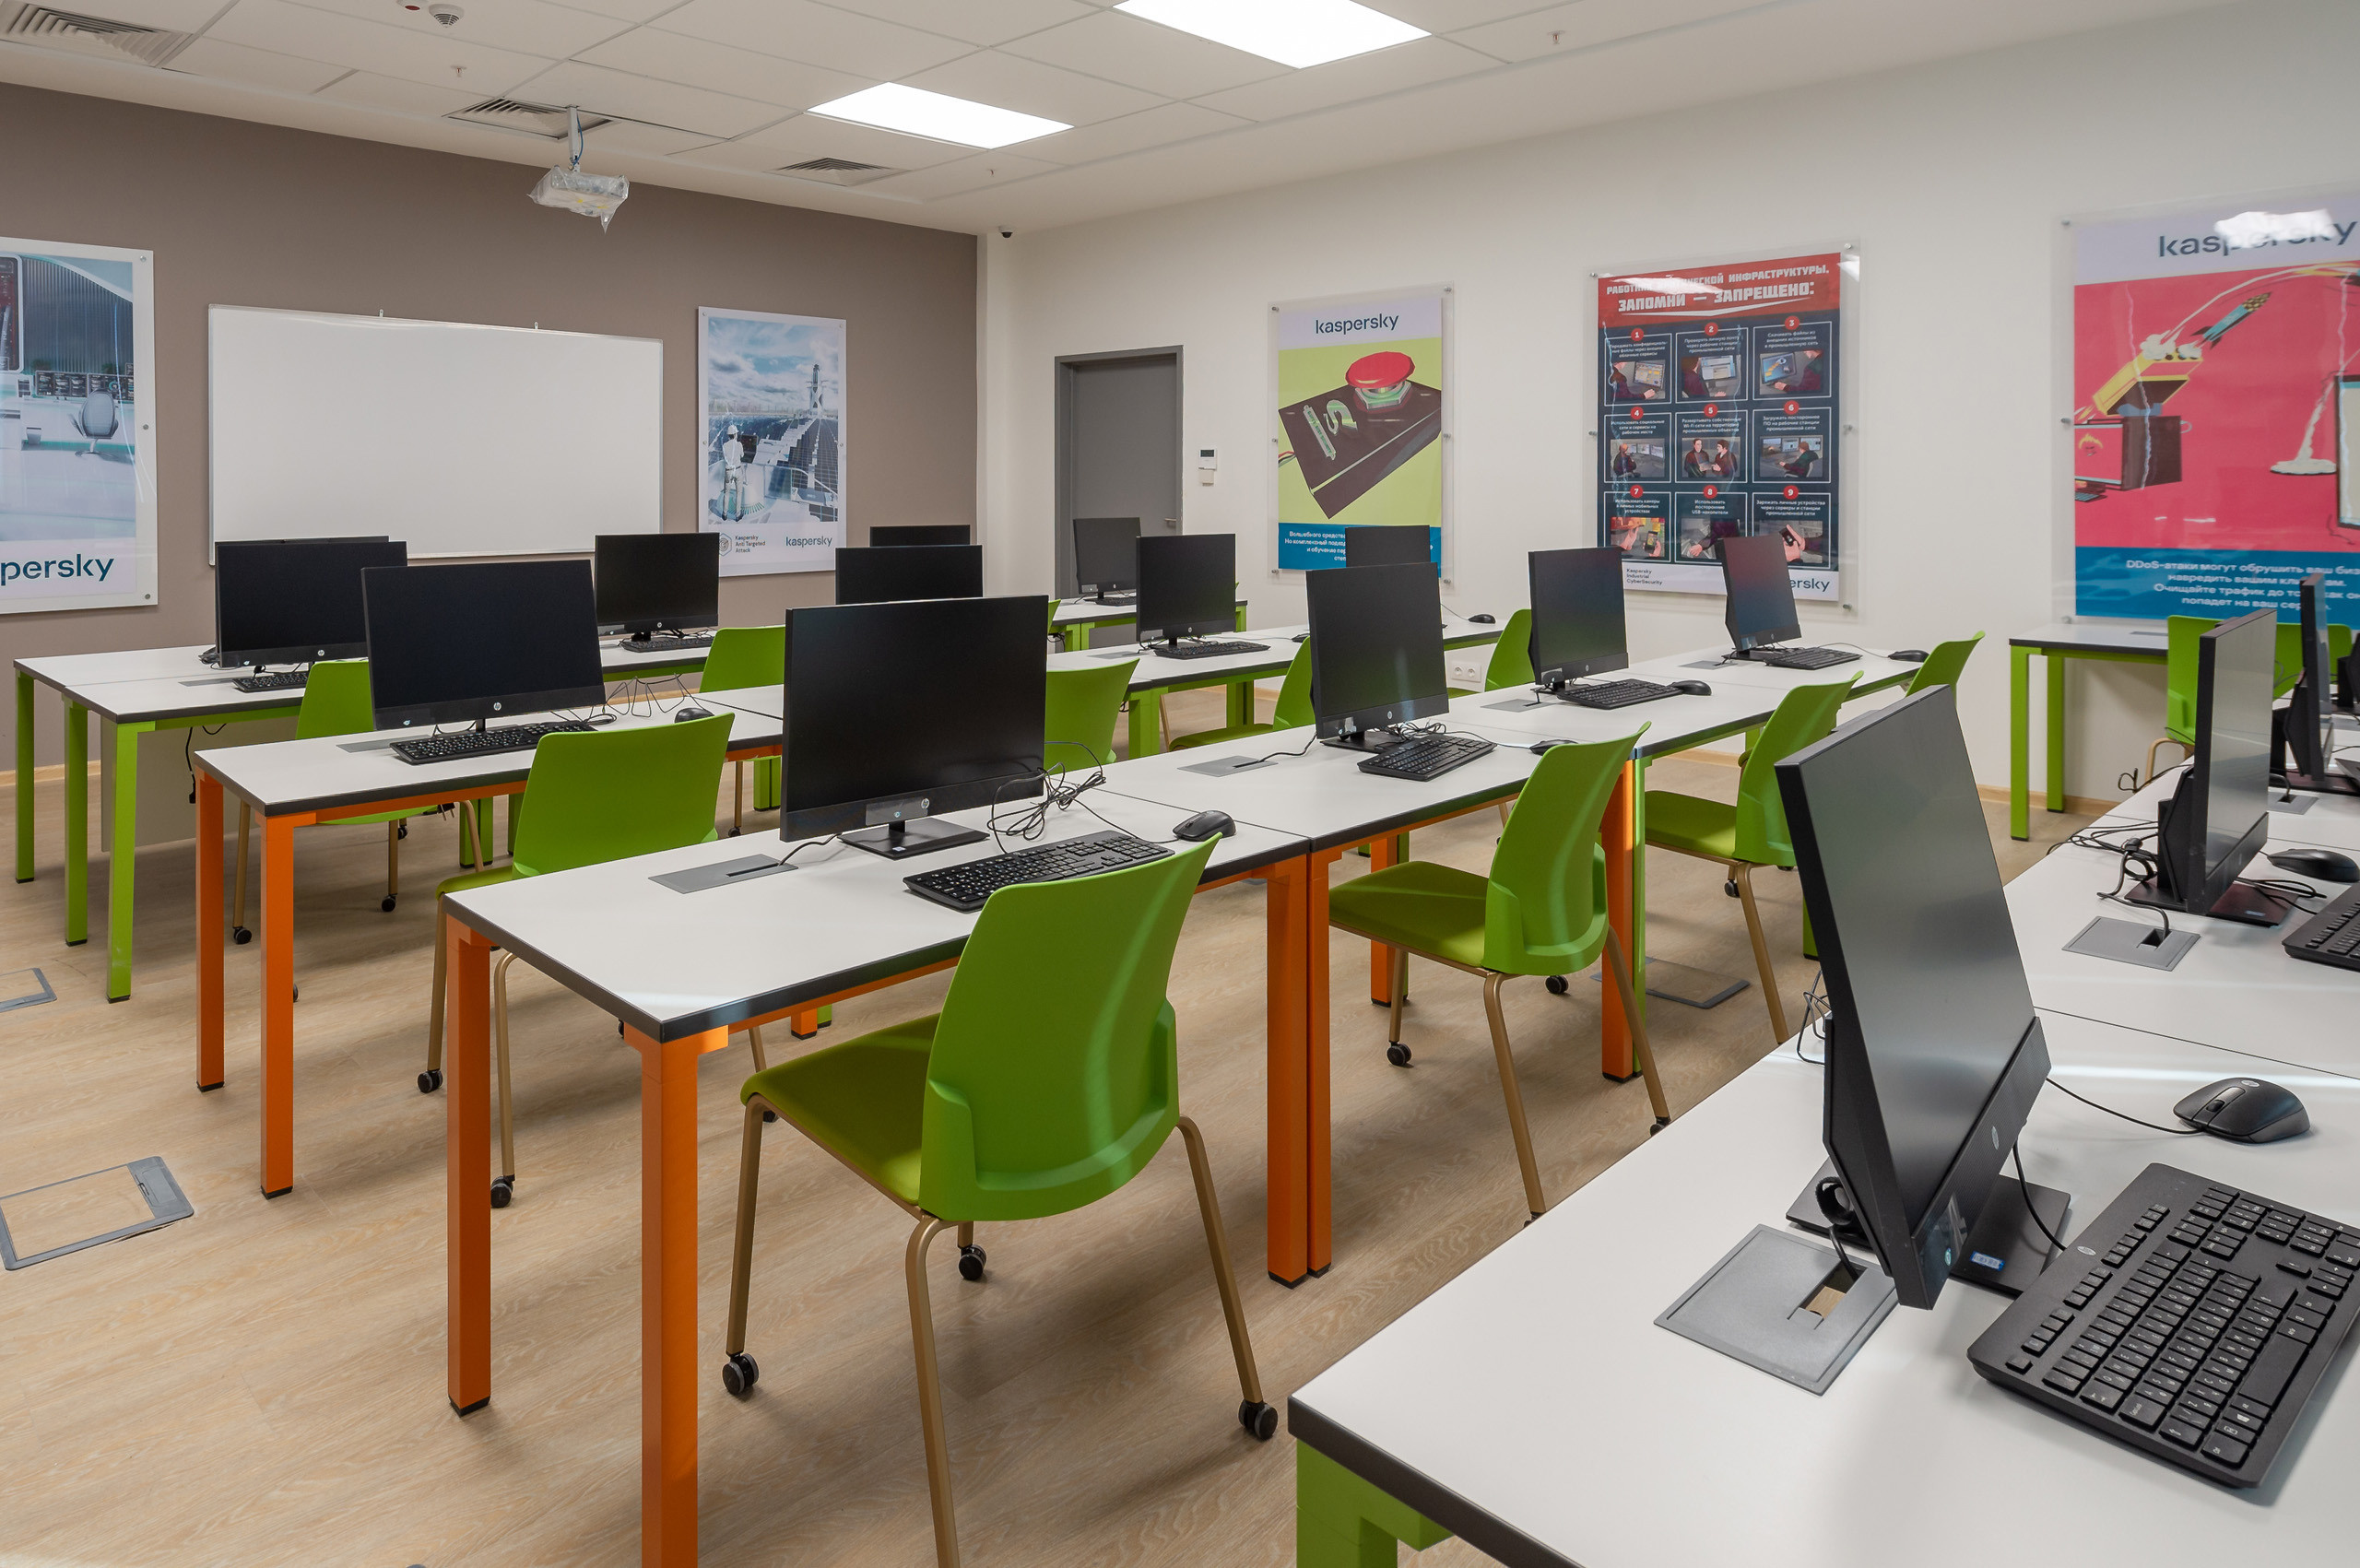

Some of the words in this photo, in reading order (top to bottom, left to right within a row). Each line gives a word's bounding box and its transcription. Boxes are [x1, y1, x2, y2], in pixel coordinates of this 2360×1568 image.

[1729, 265, 1829, 283] ИНФРАСТРУКТУРЫ.
[1618, 293, 1685, 312] ЗАПОМНИ
[1714, 281, 1814, 303] ЗАПРЕЩЕНО:
[1316, 313, 1399, 335] kaspersky
[1707, 407, 1714, 415] 5
[1707, 488, 1713, 496] 8
[785, 536, 832, 548] kaspersky
[0, 553, 114, 586] persky
[2126, 560, 2199, 570] DDoS-атаки
[2200, 563, 2237, 572] могут
[2239, 563, 2305, 574] обрушить
[2167, 574, 2233, 584] навредить
[2234, 576, 2278, 584] вашим
[2154, 583, 2217, 594] Очищайте
[2219, 587, 2265, 596] трафик
[2181, 597, 2232, 607] попадет
